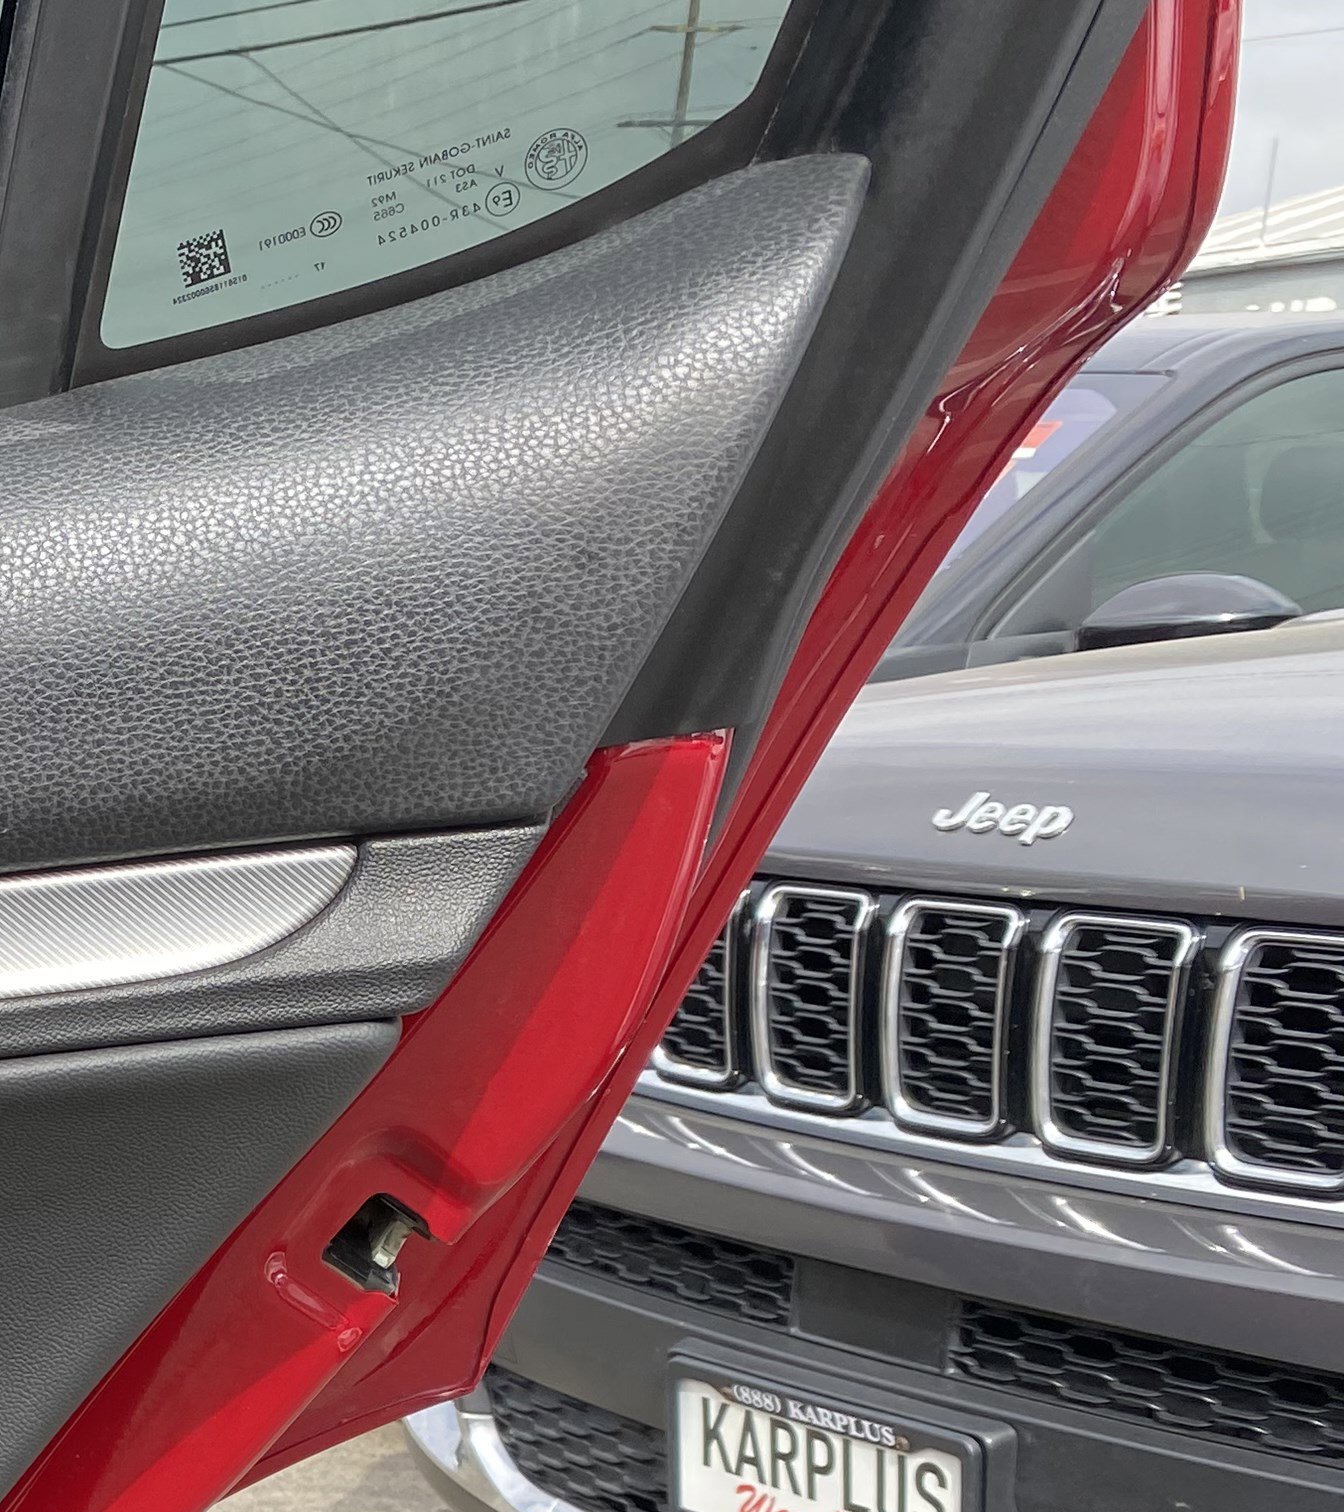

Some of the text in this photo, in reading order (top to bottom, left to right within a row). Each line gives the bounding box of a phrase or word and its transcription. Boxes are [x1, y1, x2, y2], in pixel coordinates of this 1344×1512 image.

[931, 791, 1075, 846] Jeep
[732, 1383, 896, 1447] (888) KARPLUS
